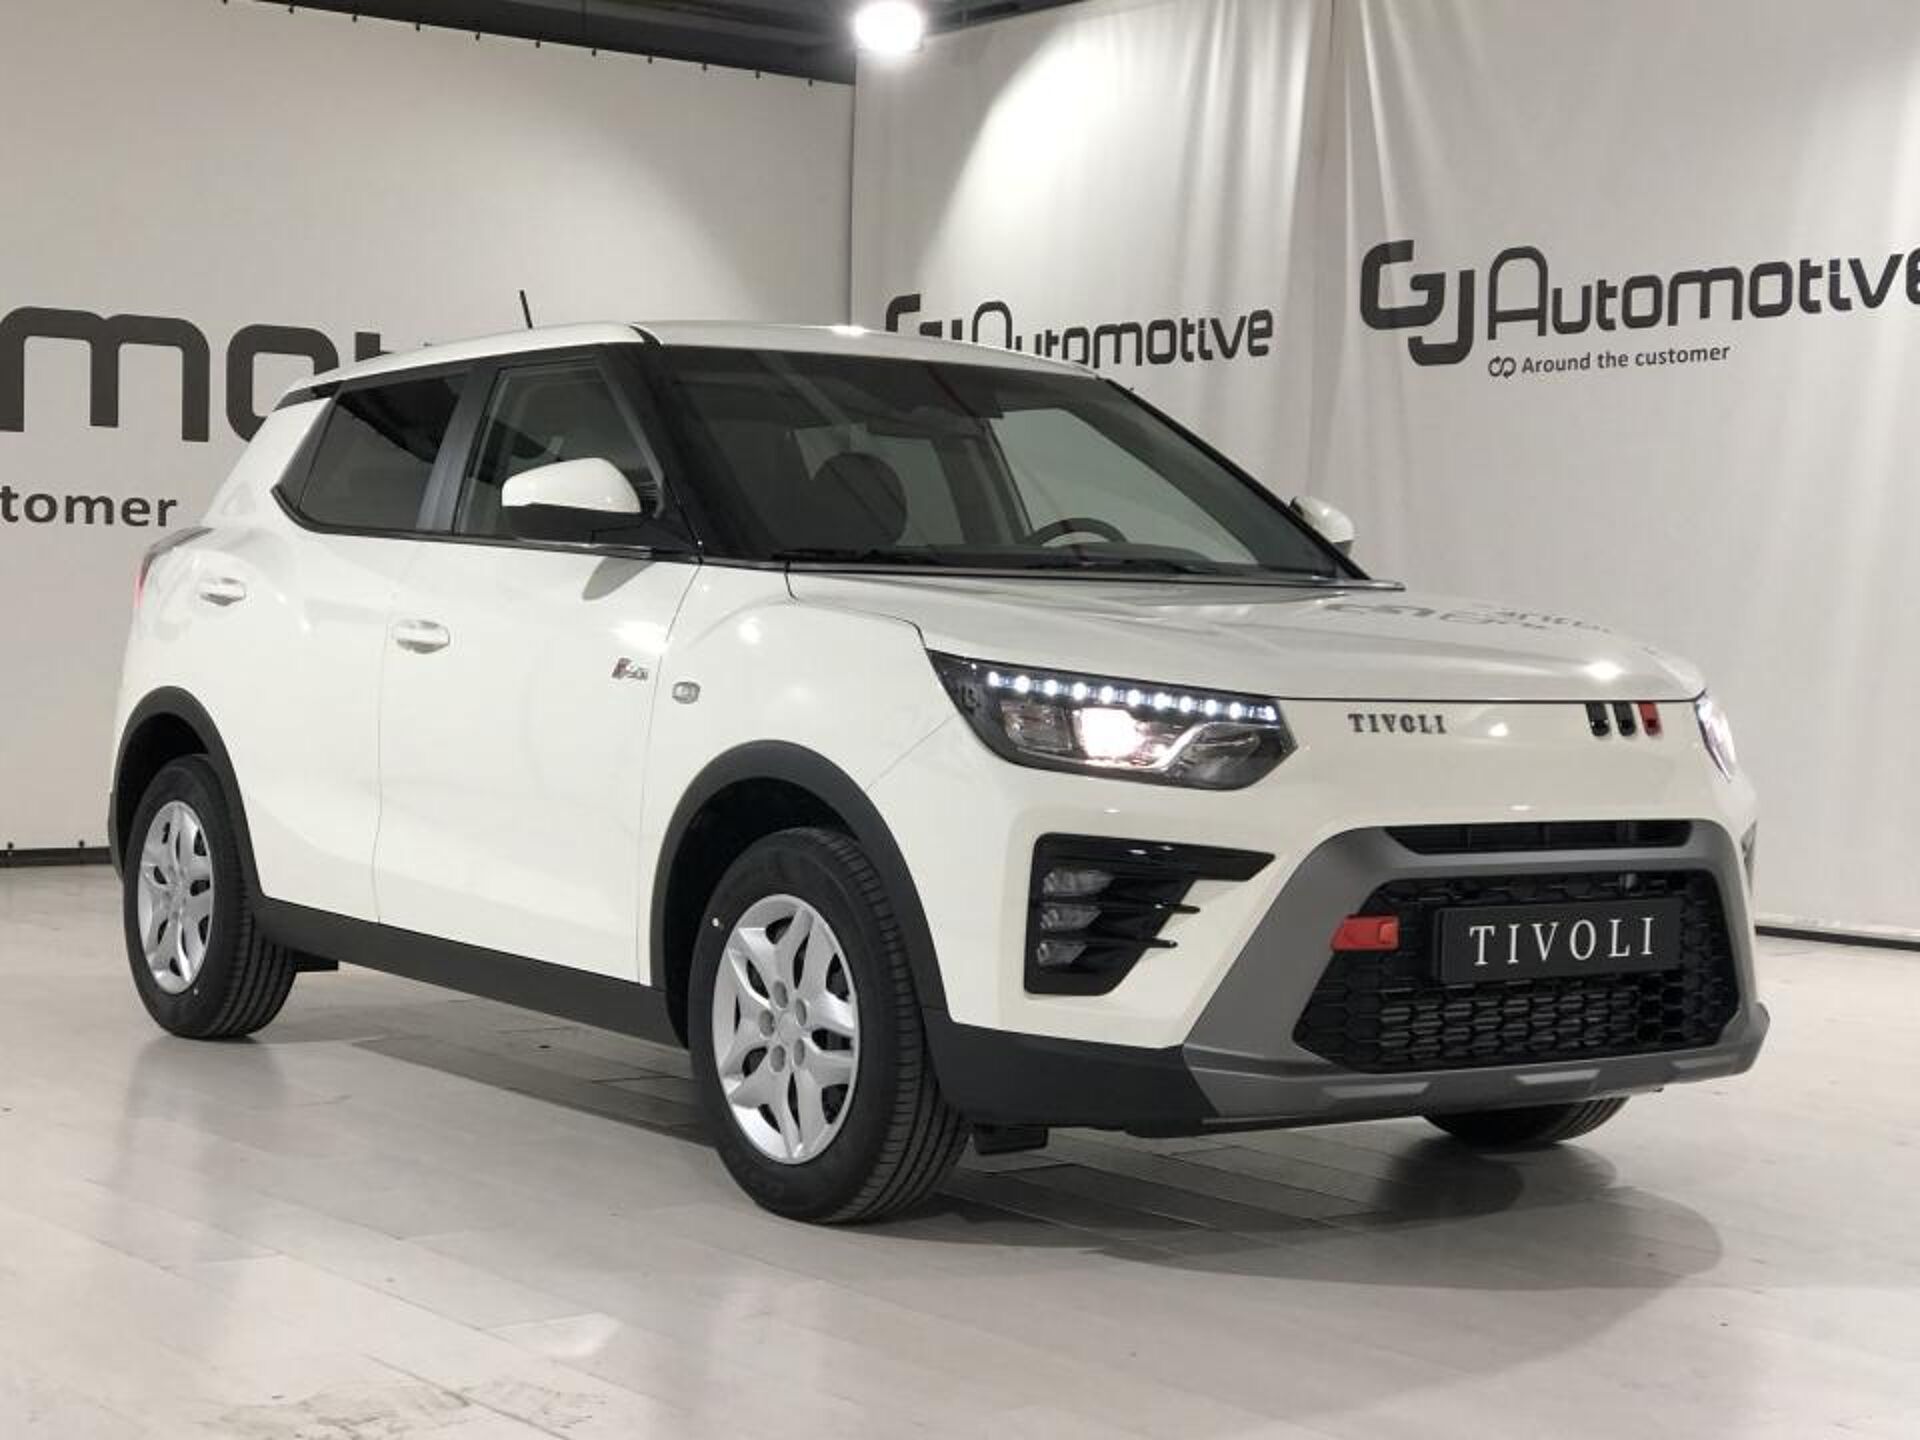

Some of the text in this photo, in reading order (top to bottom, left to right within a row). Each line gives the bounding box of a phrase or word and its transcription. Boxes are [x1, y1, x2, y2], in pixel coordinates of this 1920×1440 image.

[1521, 346, 1731, 373] Around the customer
[1347, 713, 1447, 734] TIVOLI
[1469, 917, 1654, 966] TIVOLI
